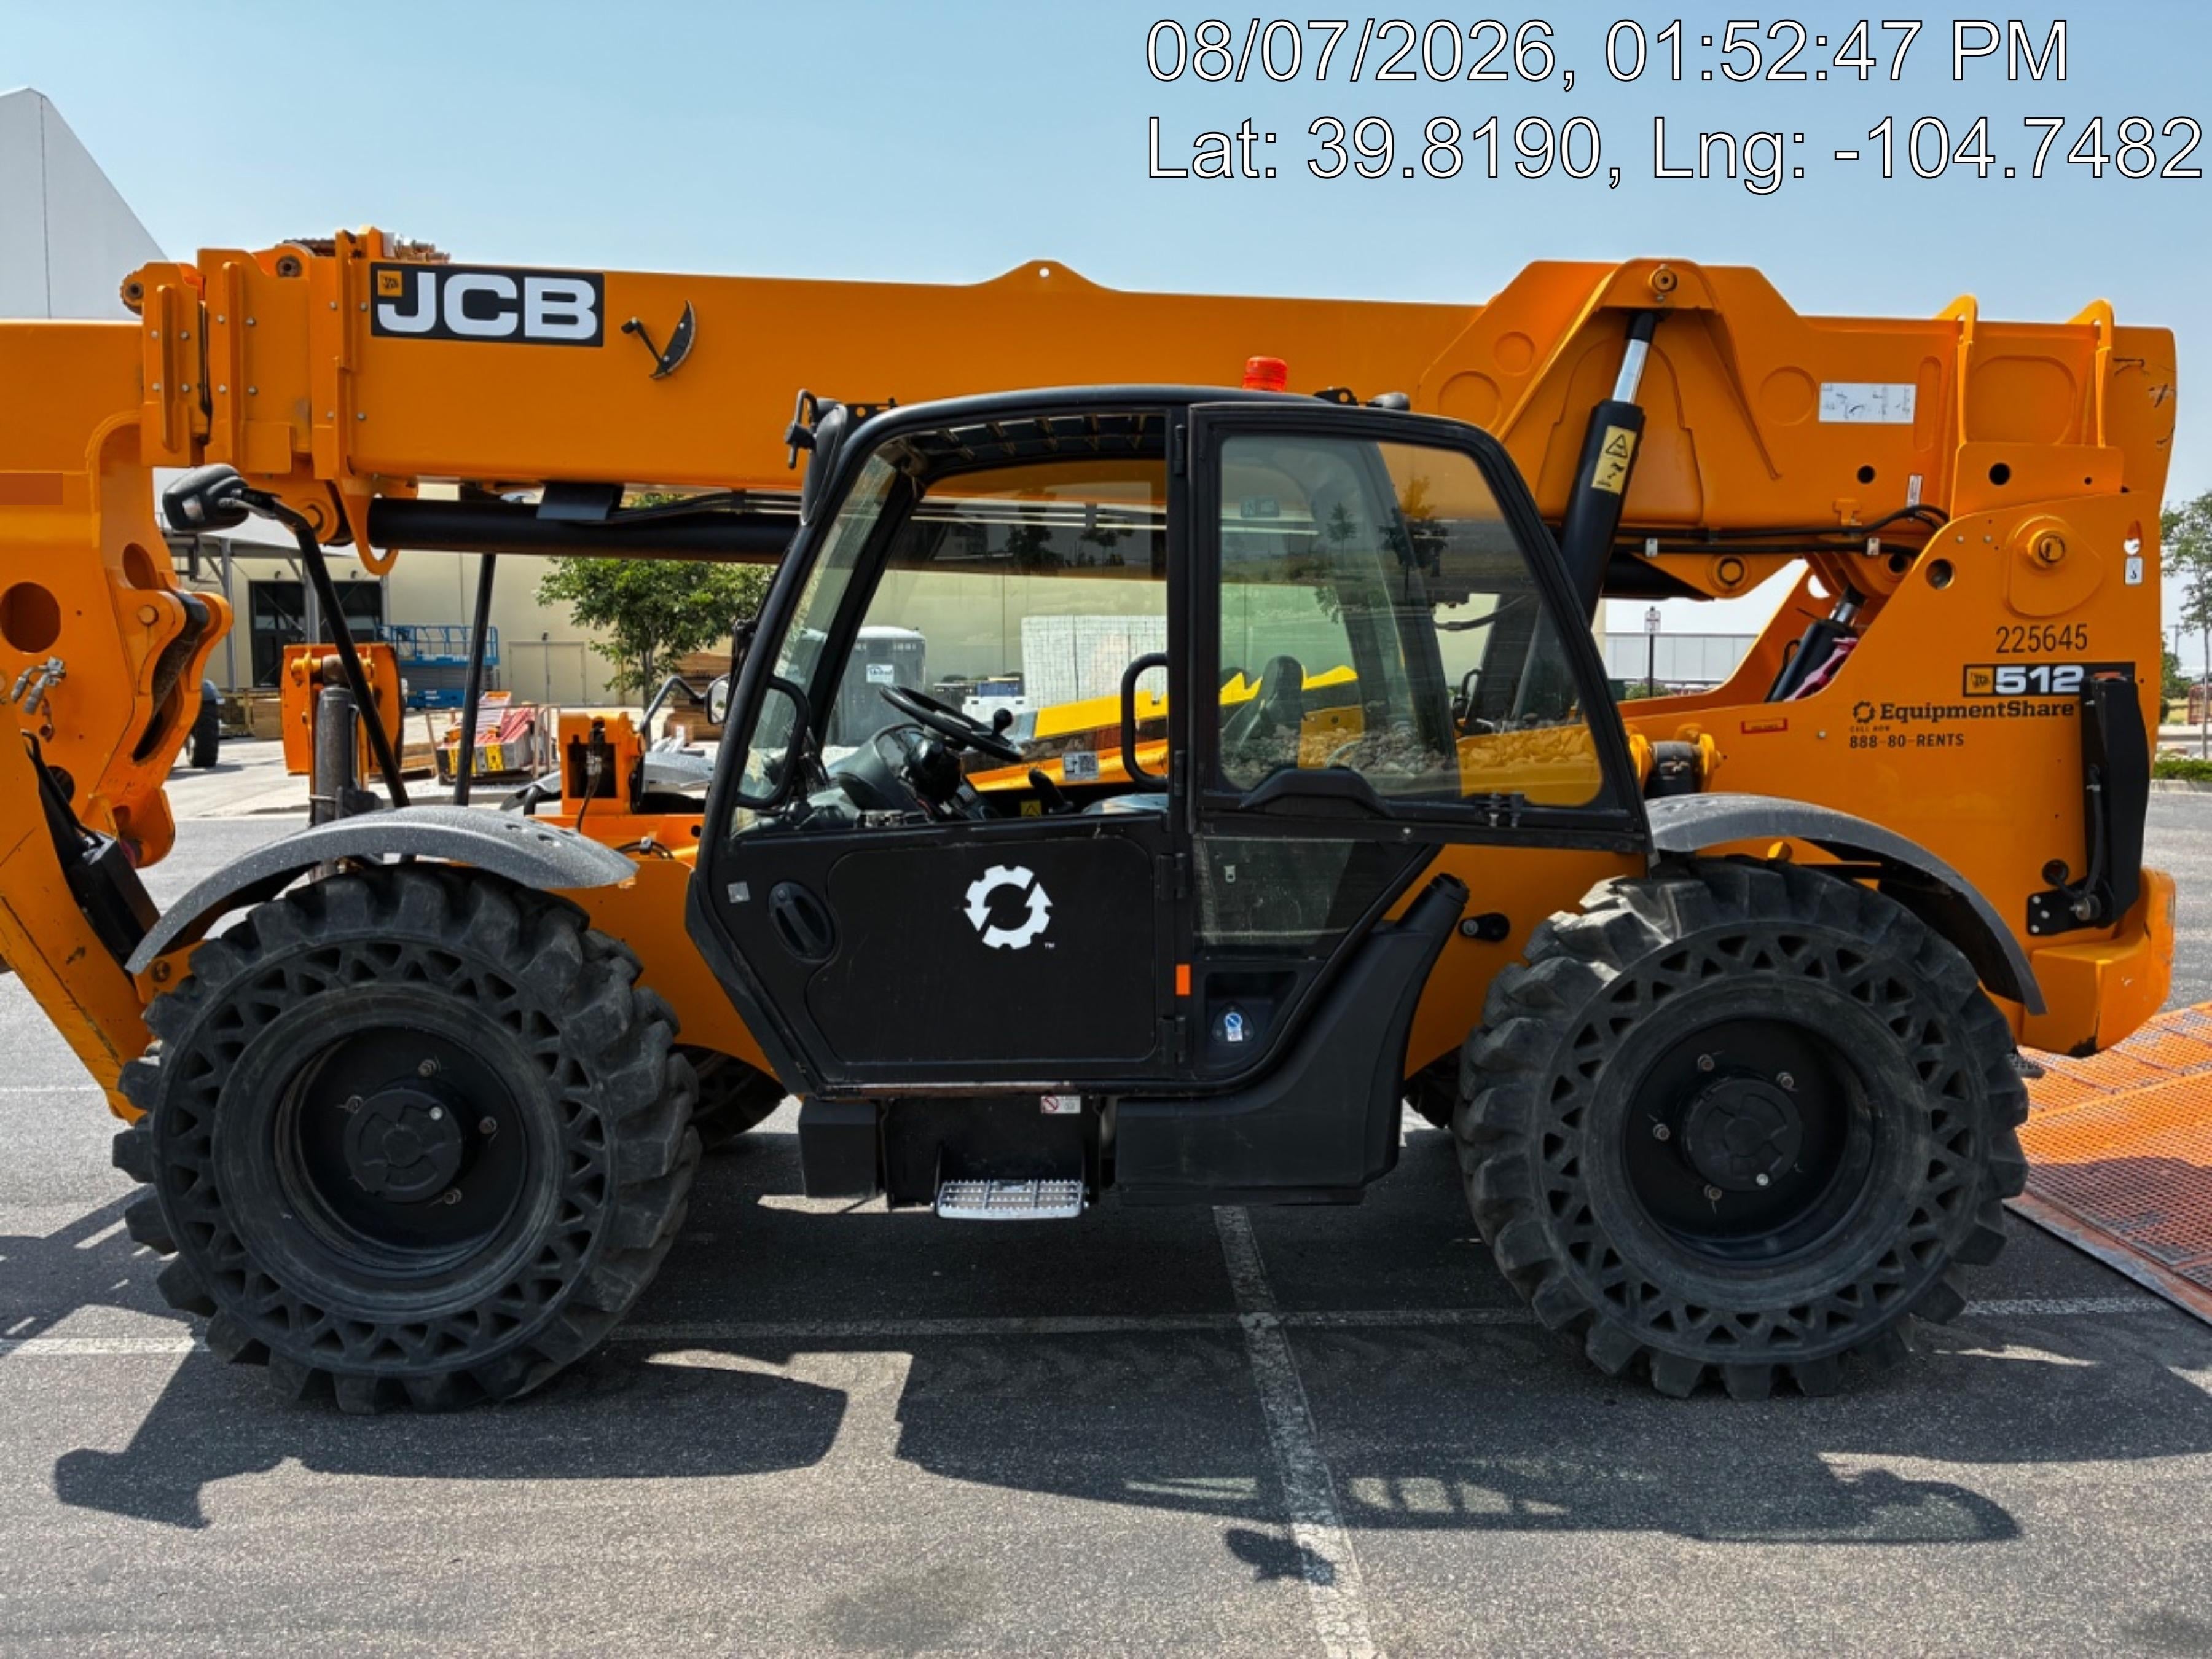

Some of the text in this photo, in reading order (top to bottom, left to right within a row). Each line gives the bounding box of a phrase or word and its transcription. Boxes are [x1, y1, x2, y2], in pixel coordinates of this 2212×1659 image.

[377, 272, 597, 339] JCB
[1996, 623, 2087, 653] 225645
[1995, 665, 2084, 694] 512
[1880, 700, 2074, 723] EquipmentShare
